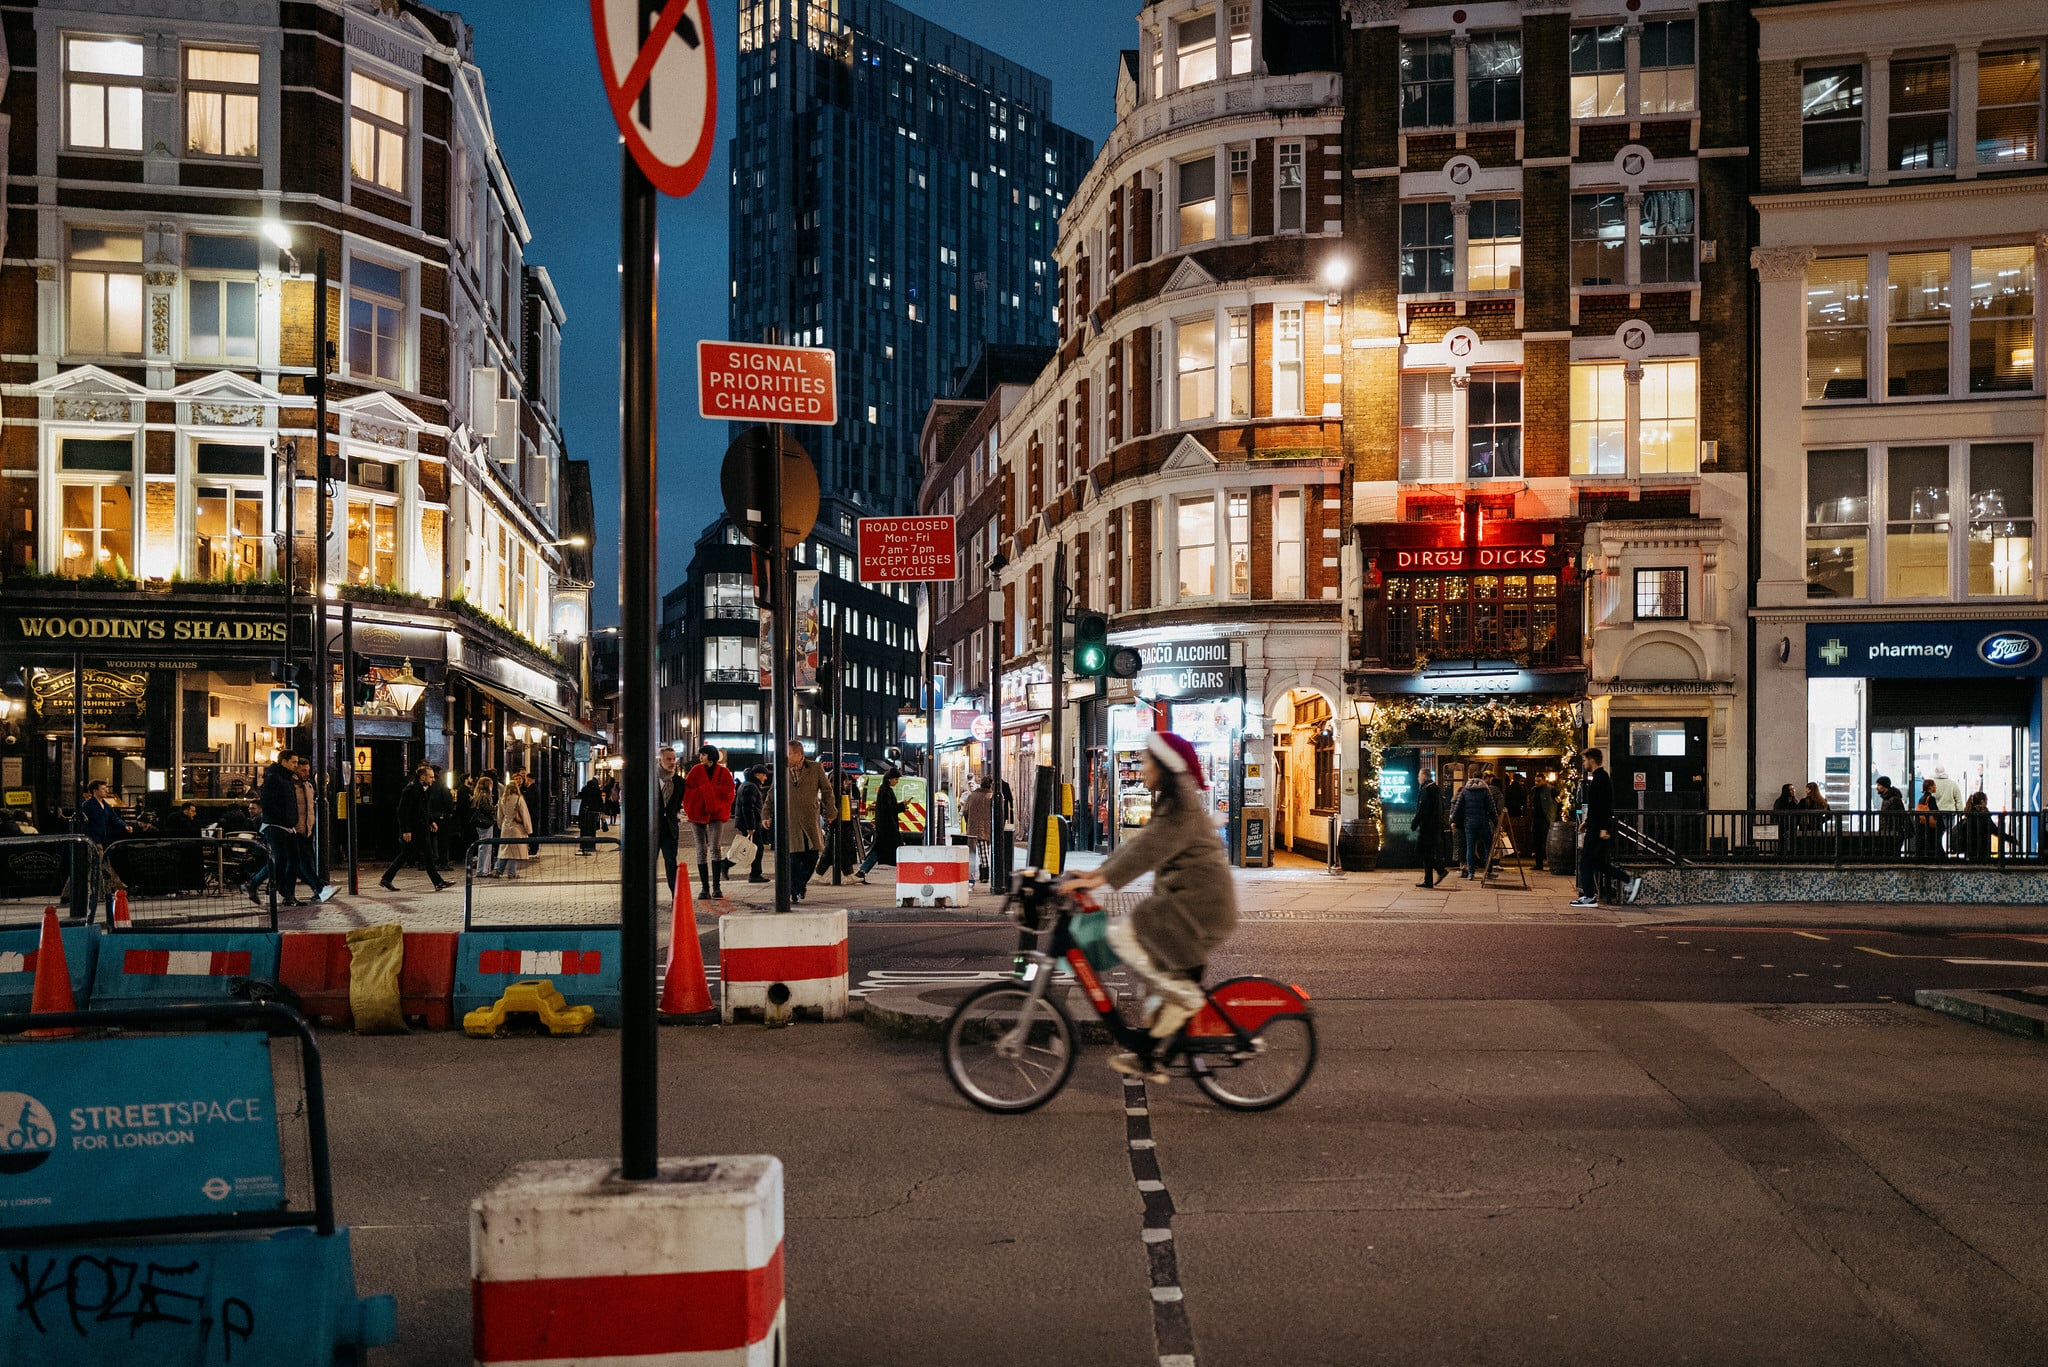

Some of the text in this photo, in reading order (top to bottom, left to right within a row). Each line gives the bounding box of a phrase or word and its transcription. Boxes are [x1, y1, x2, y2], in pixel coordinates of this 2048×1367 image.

[389, 43, 423, 74] SHADES
[728, 352, 807, 374] SIGNAL
[709, 371, 826, 395] PRIORITIES
[715, 392, 821, 415] CHANGED
[865, 520, 949, 533] ROAD CLOSED
[864, 554, 951, 567] EXCEPT BUSES
[1398, 549, 1547, 567] DIRTY DICKS
[879, 566, 936, 577] & CYCLES
[19, 617, 288, 642] WOODIN'S SHADES
[1138, 644, 1228, 665] BACCO ALCOHOL
[1868, 638, 2030, 660] pharmacy Boots
[106, 660, 198, 669] WOODIN'S SHADES
[1180, 671, 1224, 689] CIGARS
[1473, 679, 1510, 691] DICKS
[1661, 684, 1720, 694] CHAMBERS
[70, 1099, 263, 1131] STREETSPACE
[72, 1130, 195, 1151] FOR LONDON
